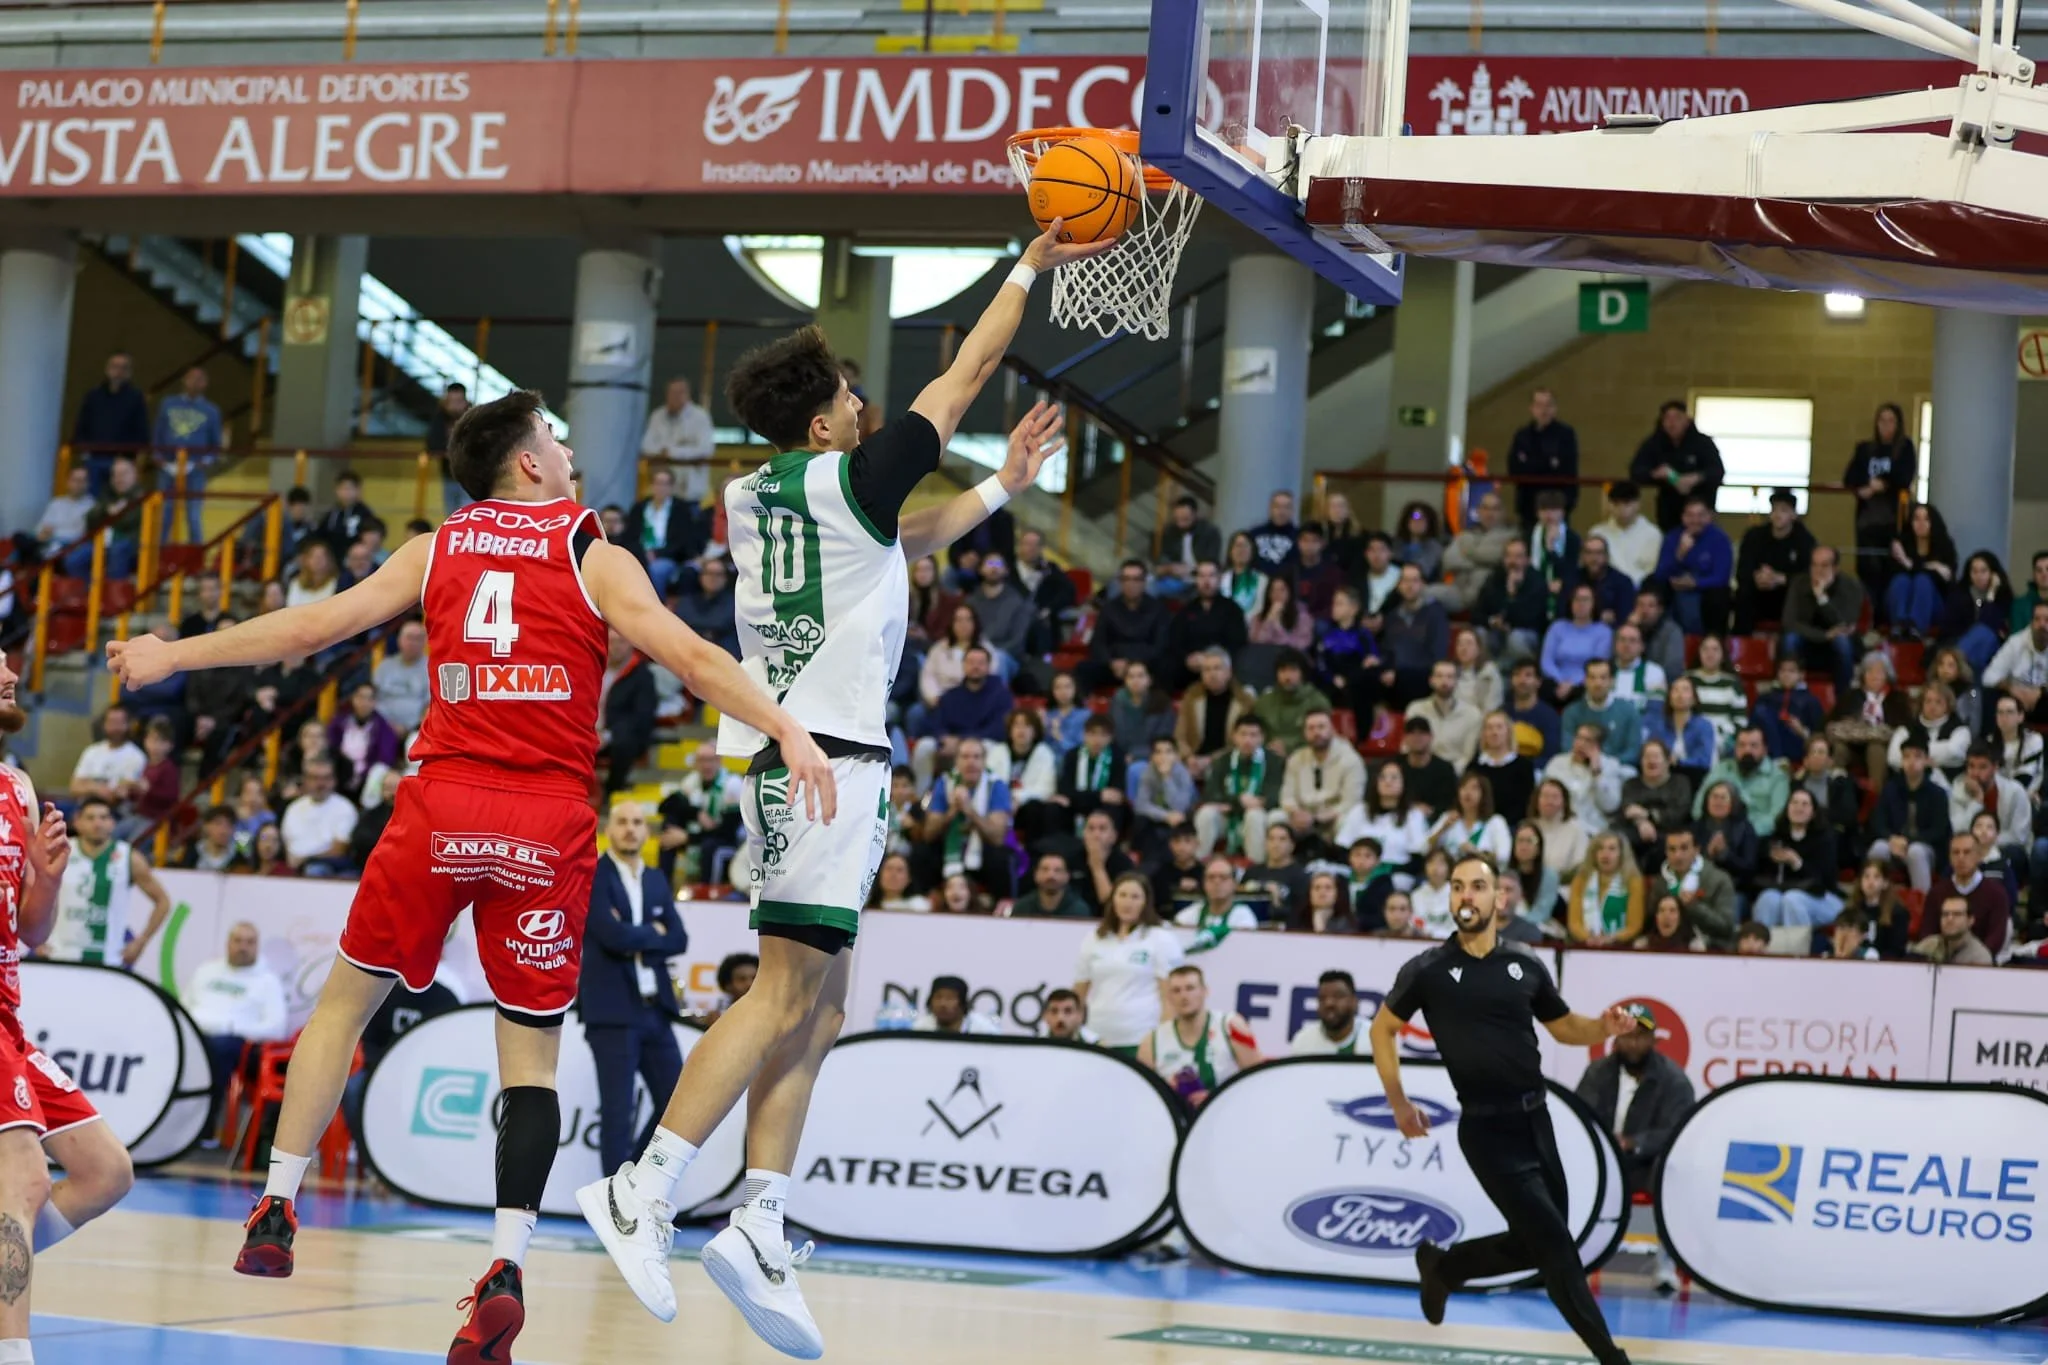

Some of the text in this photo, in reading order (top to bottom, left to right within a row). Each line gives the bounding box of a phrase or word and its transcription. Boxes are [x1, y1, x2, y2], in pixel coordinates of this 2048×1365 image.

[18, 72, 470, 108] PALACIO MUNICIPAL DEPORTES
[1539, 86, 1750, 124] AYUNTAMIENTO
[0, 112, 509, 187] VISTA ALEGRE
[702, 159, 801, 185] Instituto
[806, 159, 929, 186] Municipal
[932, 160, 966, 185] de
[1598, 288, 1629, 328] D
[447, 528, 549, 559] FÀBREGA
[752, 505, 806, 594] 10
[463, 569, 520, 658] 4
[478, 666, 570, 693] IXMA
[505, 936, 574, 958] HYUNDAI
[516, 953, 567, 970] Lemauto
[1704, 1016, 1898, 1056] GESTORÍA
[1333, 1132, 1445, 1172] TYSA
[804, 1156, 1111, 1200] ATRESVEGA
[1818, 1147, 2040, 1203] REALE
[1317, 1194, 1432, 1248] Ford
[1812, 1201, 2034, 1243] SEGUROS
